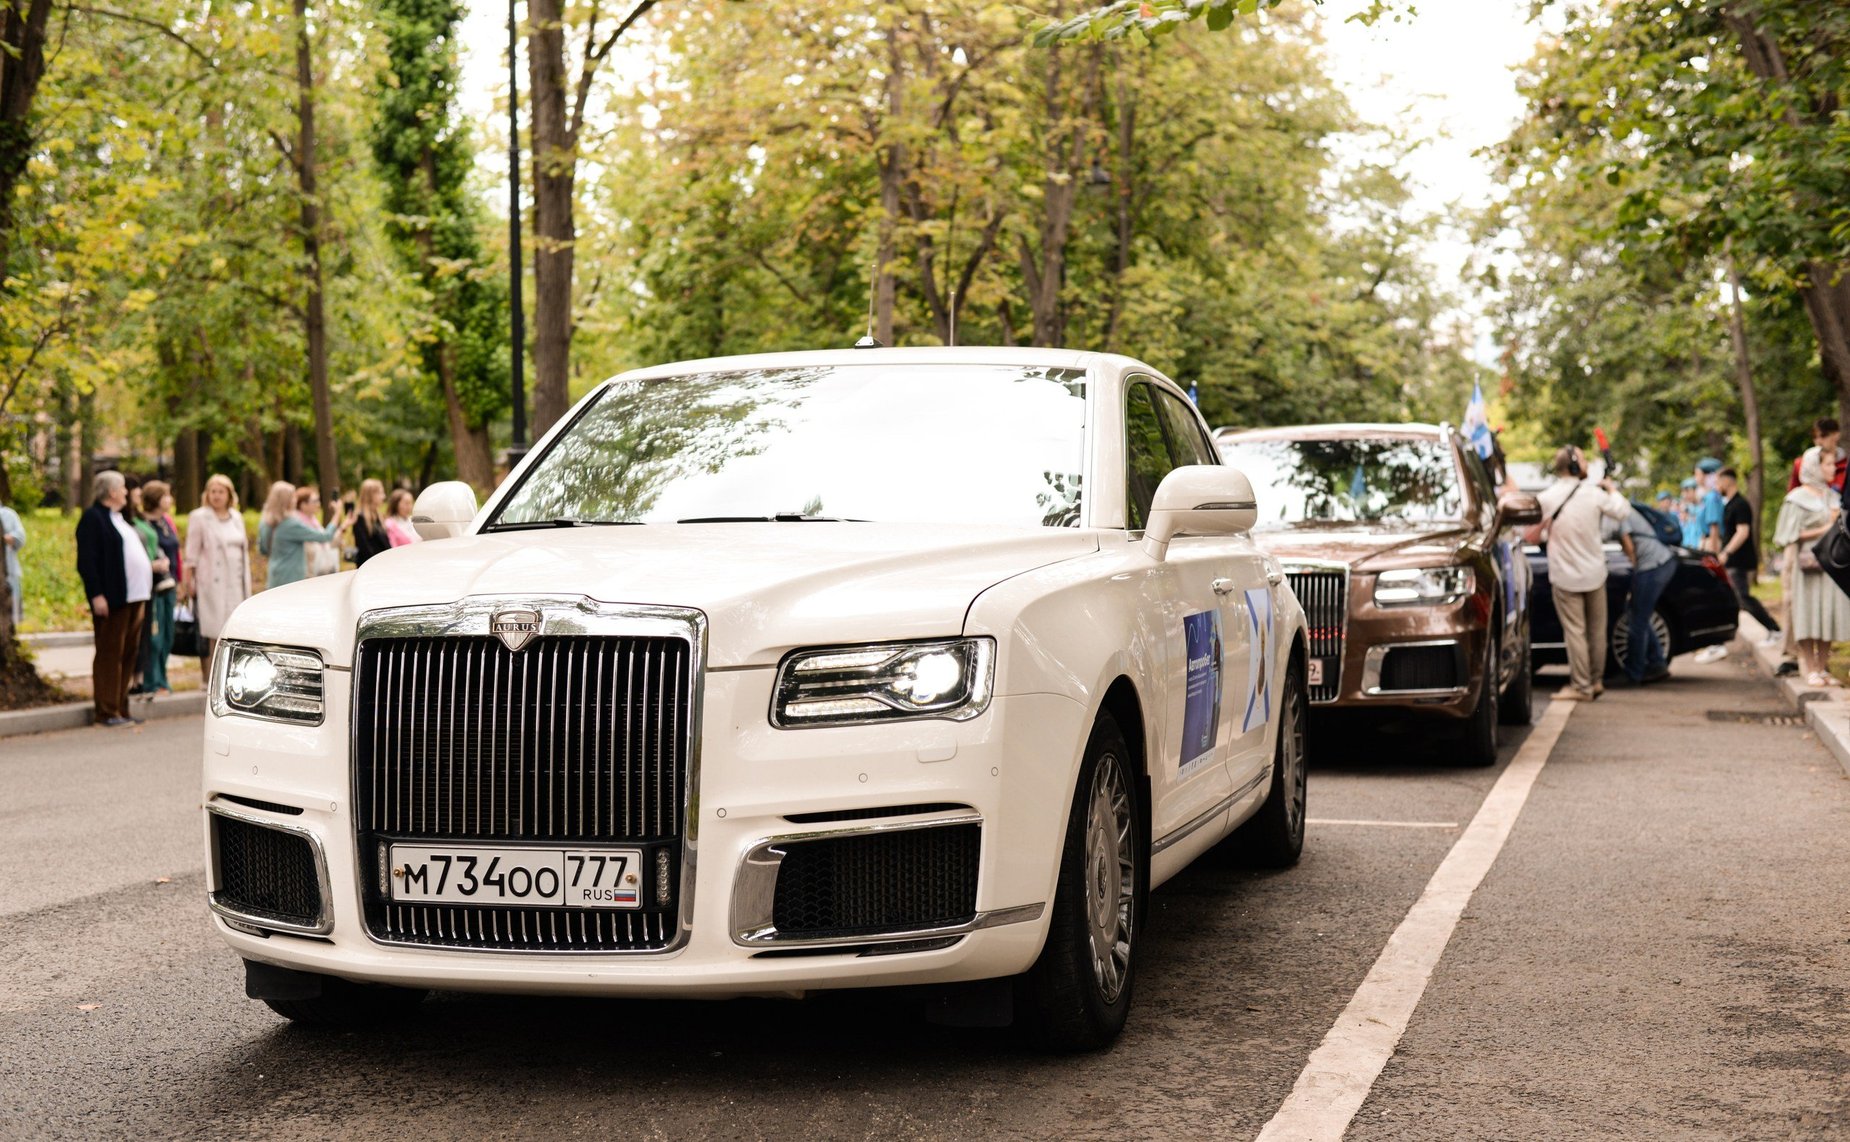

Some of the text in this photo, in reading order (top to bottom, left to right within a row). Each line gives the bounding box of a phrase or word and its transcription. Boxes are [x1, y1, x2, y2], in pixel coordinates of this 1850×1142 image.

[496, 623, 537, 631] AURUS
[567, 856, 628, 887] 777
[583, 889, 613, 900] RUS
